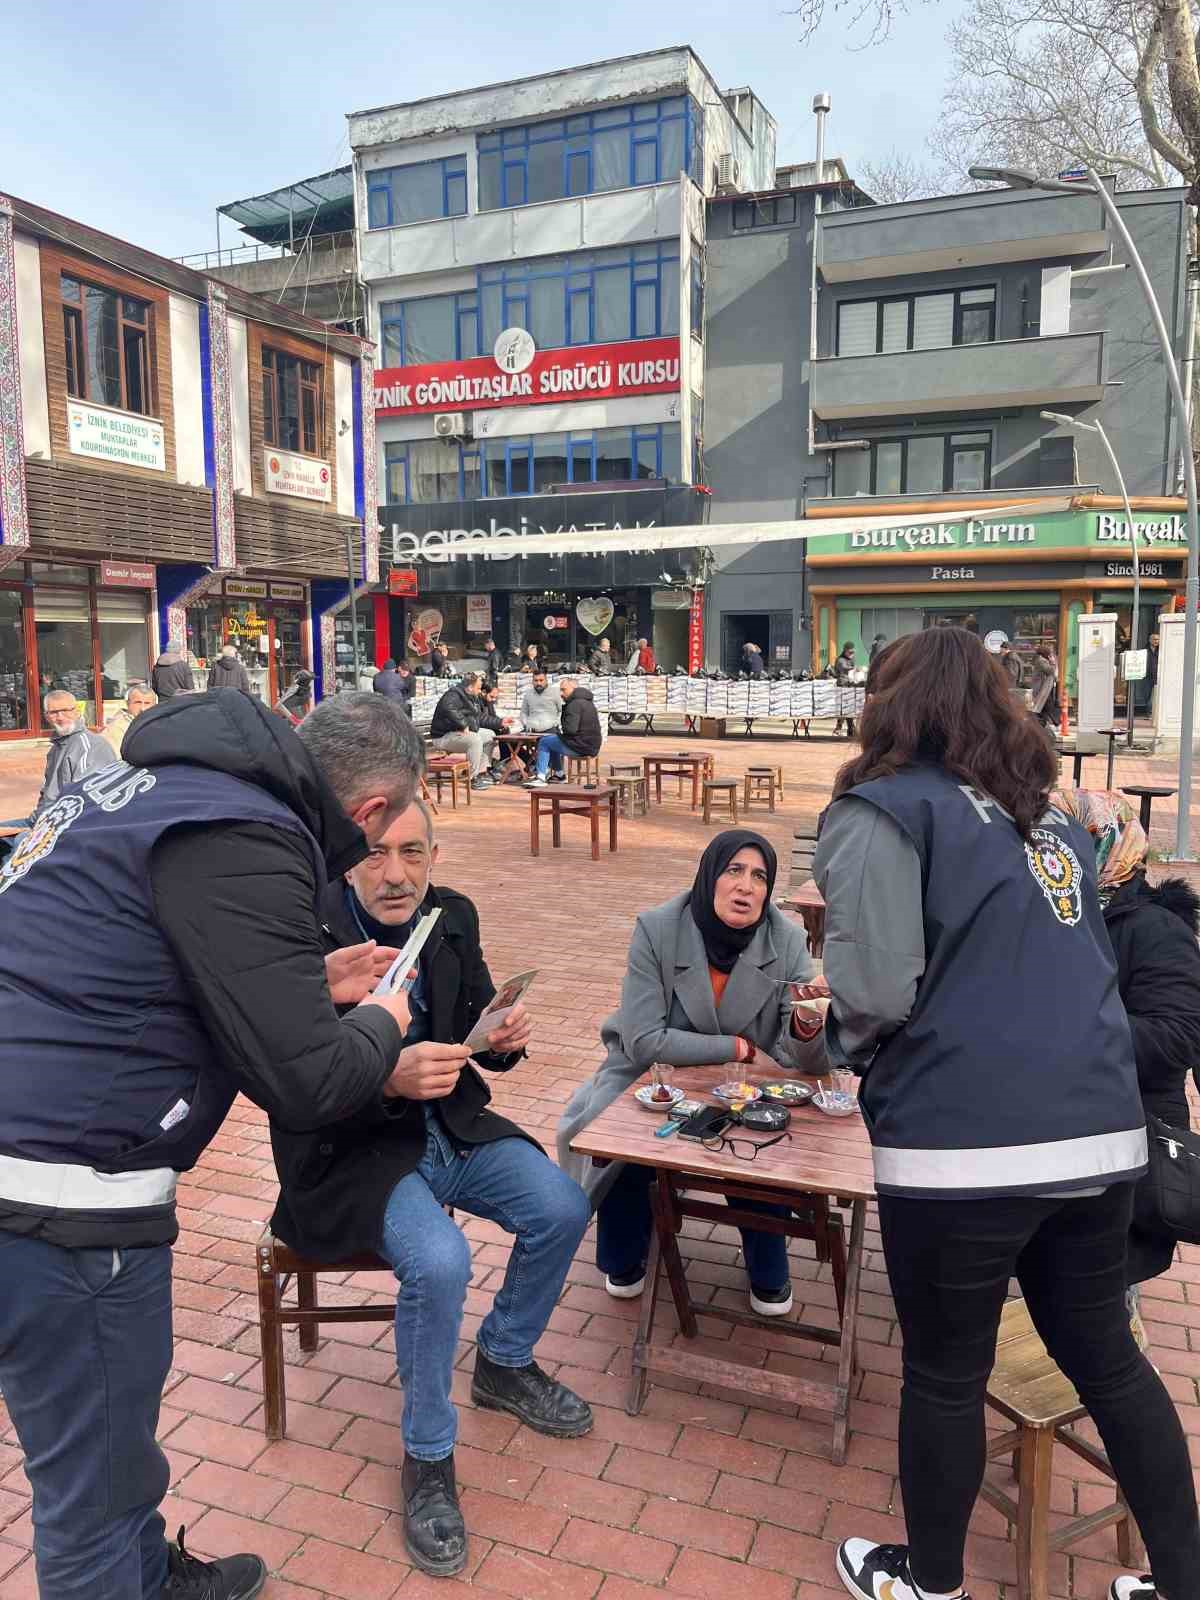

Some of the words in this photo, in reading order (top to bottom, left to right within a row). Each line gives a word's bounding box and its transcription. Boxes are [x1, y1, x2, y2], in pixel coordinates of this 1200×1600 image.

[373, 381, 412, 408] ZNİK
[415, 373, 533, 405] GÖNÜLTAŞLAR
[539, 360, 611, 394] SÜRÜCÜ
[618, 358, 679, 387] KURSU
[391, 516, 528, 564] bambi
[850, 523, 957, 550] Burçak
[1096, 513, 1189, 546] Burçak
[931, 566, 976, 580] Pasta
[1139, 562, 1163, 576] 1981
